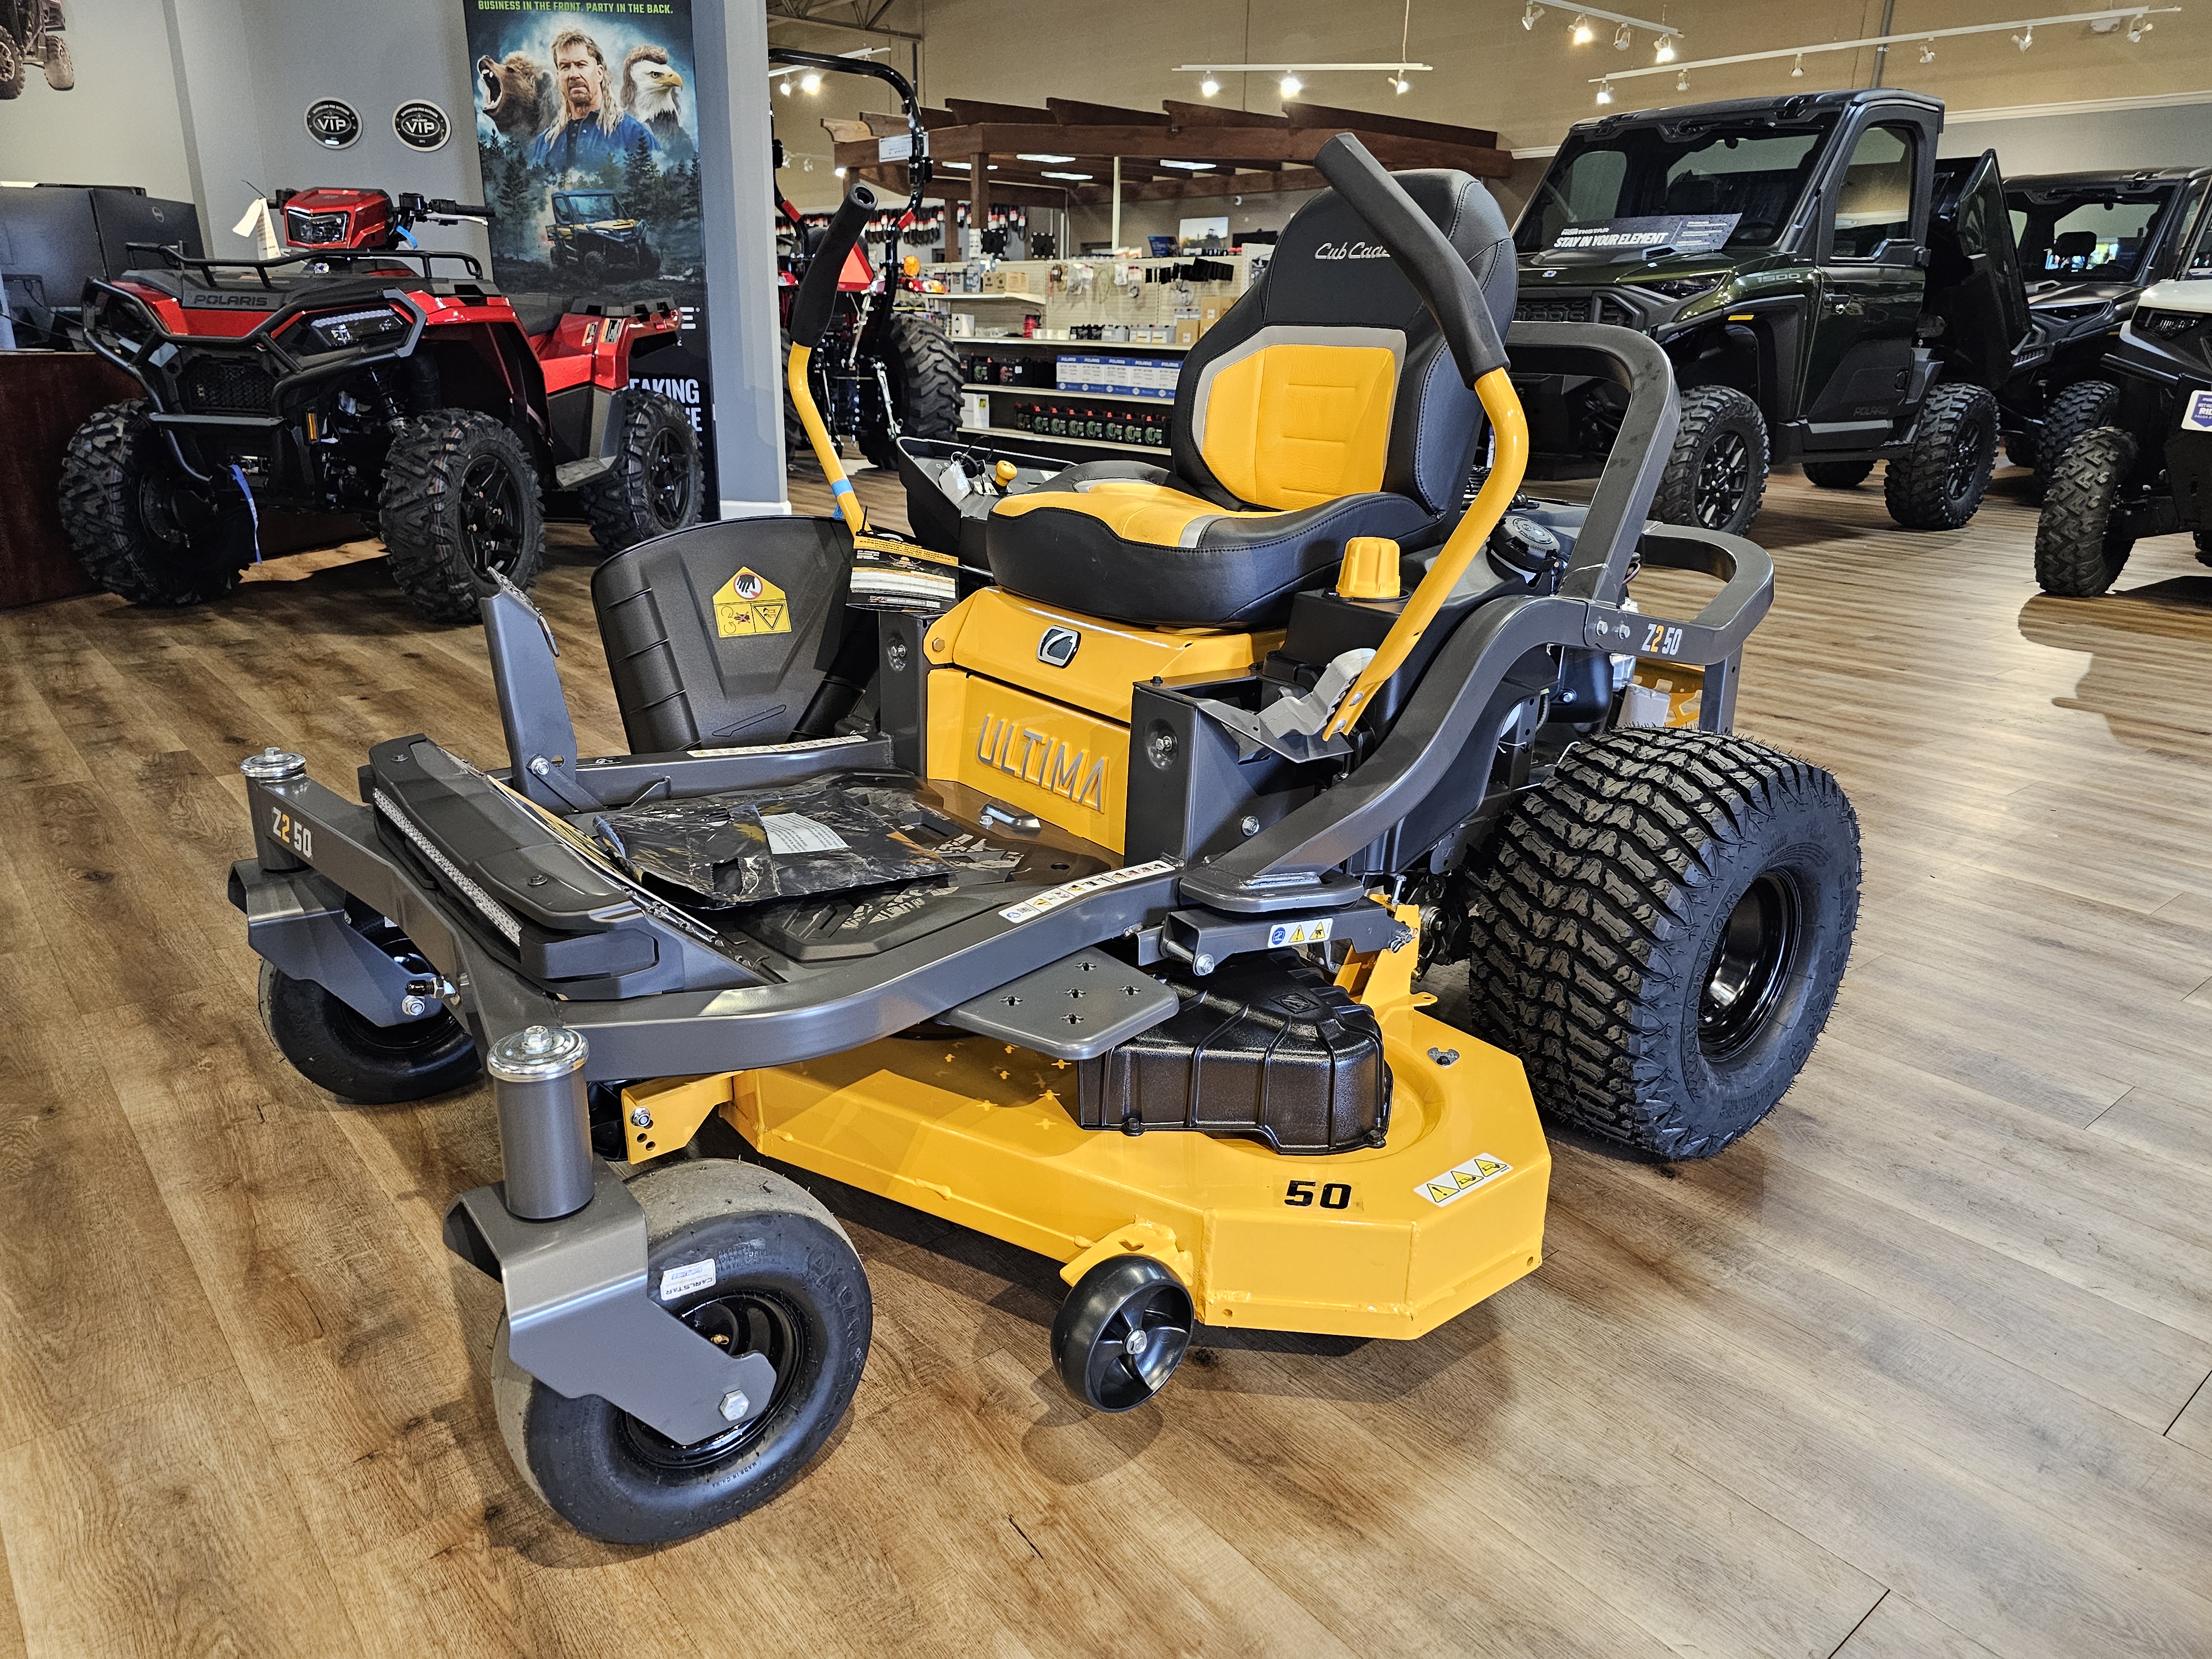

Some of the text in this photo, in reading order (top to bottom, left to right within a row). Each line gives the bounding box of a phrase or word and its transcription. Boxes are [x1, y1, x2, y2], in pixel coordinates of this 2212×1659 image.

[478, 1, 520, 10] BUSINESS
[523, 1, 532, 10] IN
[534, 2, 551, 11] THE
[586, 3, 614, 13] PARTY
[617, 3, 625, 13] IN
[628, 3, 645, 13] THE
[648, 4, 674, 14] BACK.
[317, 119, 346, 131] VIP
[405, 122, 435, 133] VIP
[1554, 237, 1579, 247] STAY
[1578, 235, 1590, 246] IN
[1592, 234, 1619, 246] YOUR
[1619, 232, 1669, 244] ELEMENT
[1314, 242, 1390, 259] Cub Cade
[1757, 273, 1801, 283] 1500
[194, 294, 268, 306] POLARIS
[1641, 623, 1683, 655] Z2 50
[976, 713, 1109, 814] ULTIMA
[273, 807, 312, 858] Z2 50
[1284, 1180, 1352, 1209] 50
[665, 1277, 713, 1296] CARLSTAR
[711, 1462, 757, 1488] MADE IN CHINA
